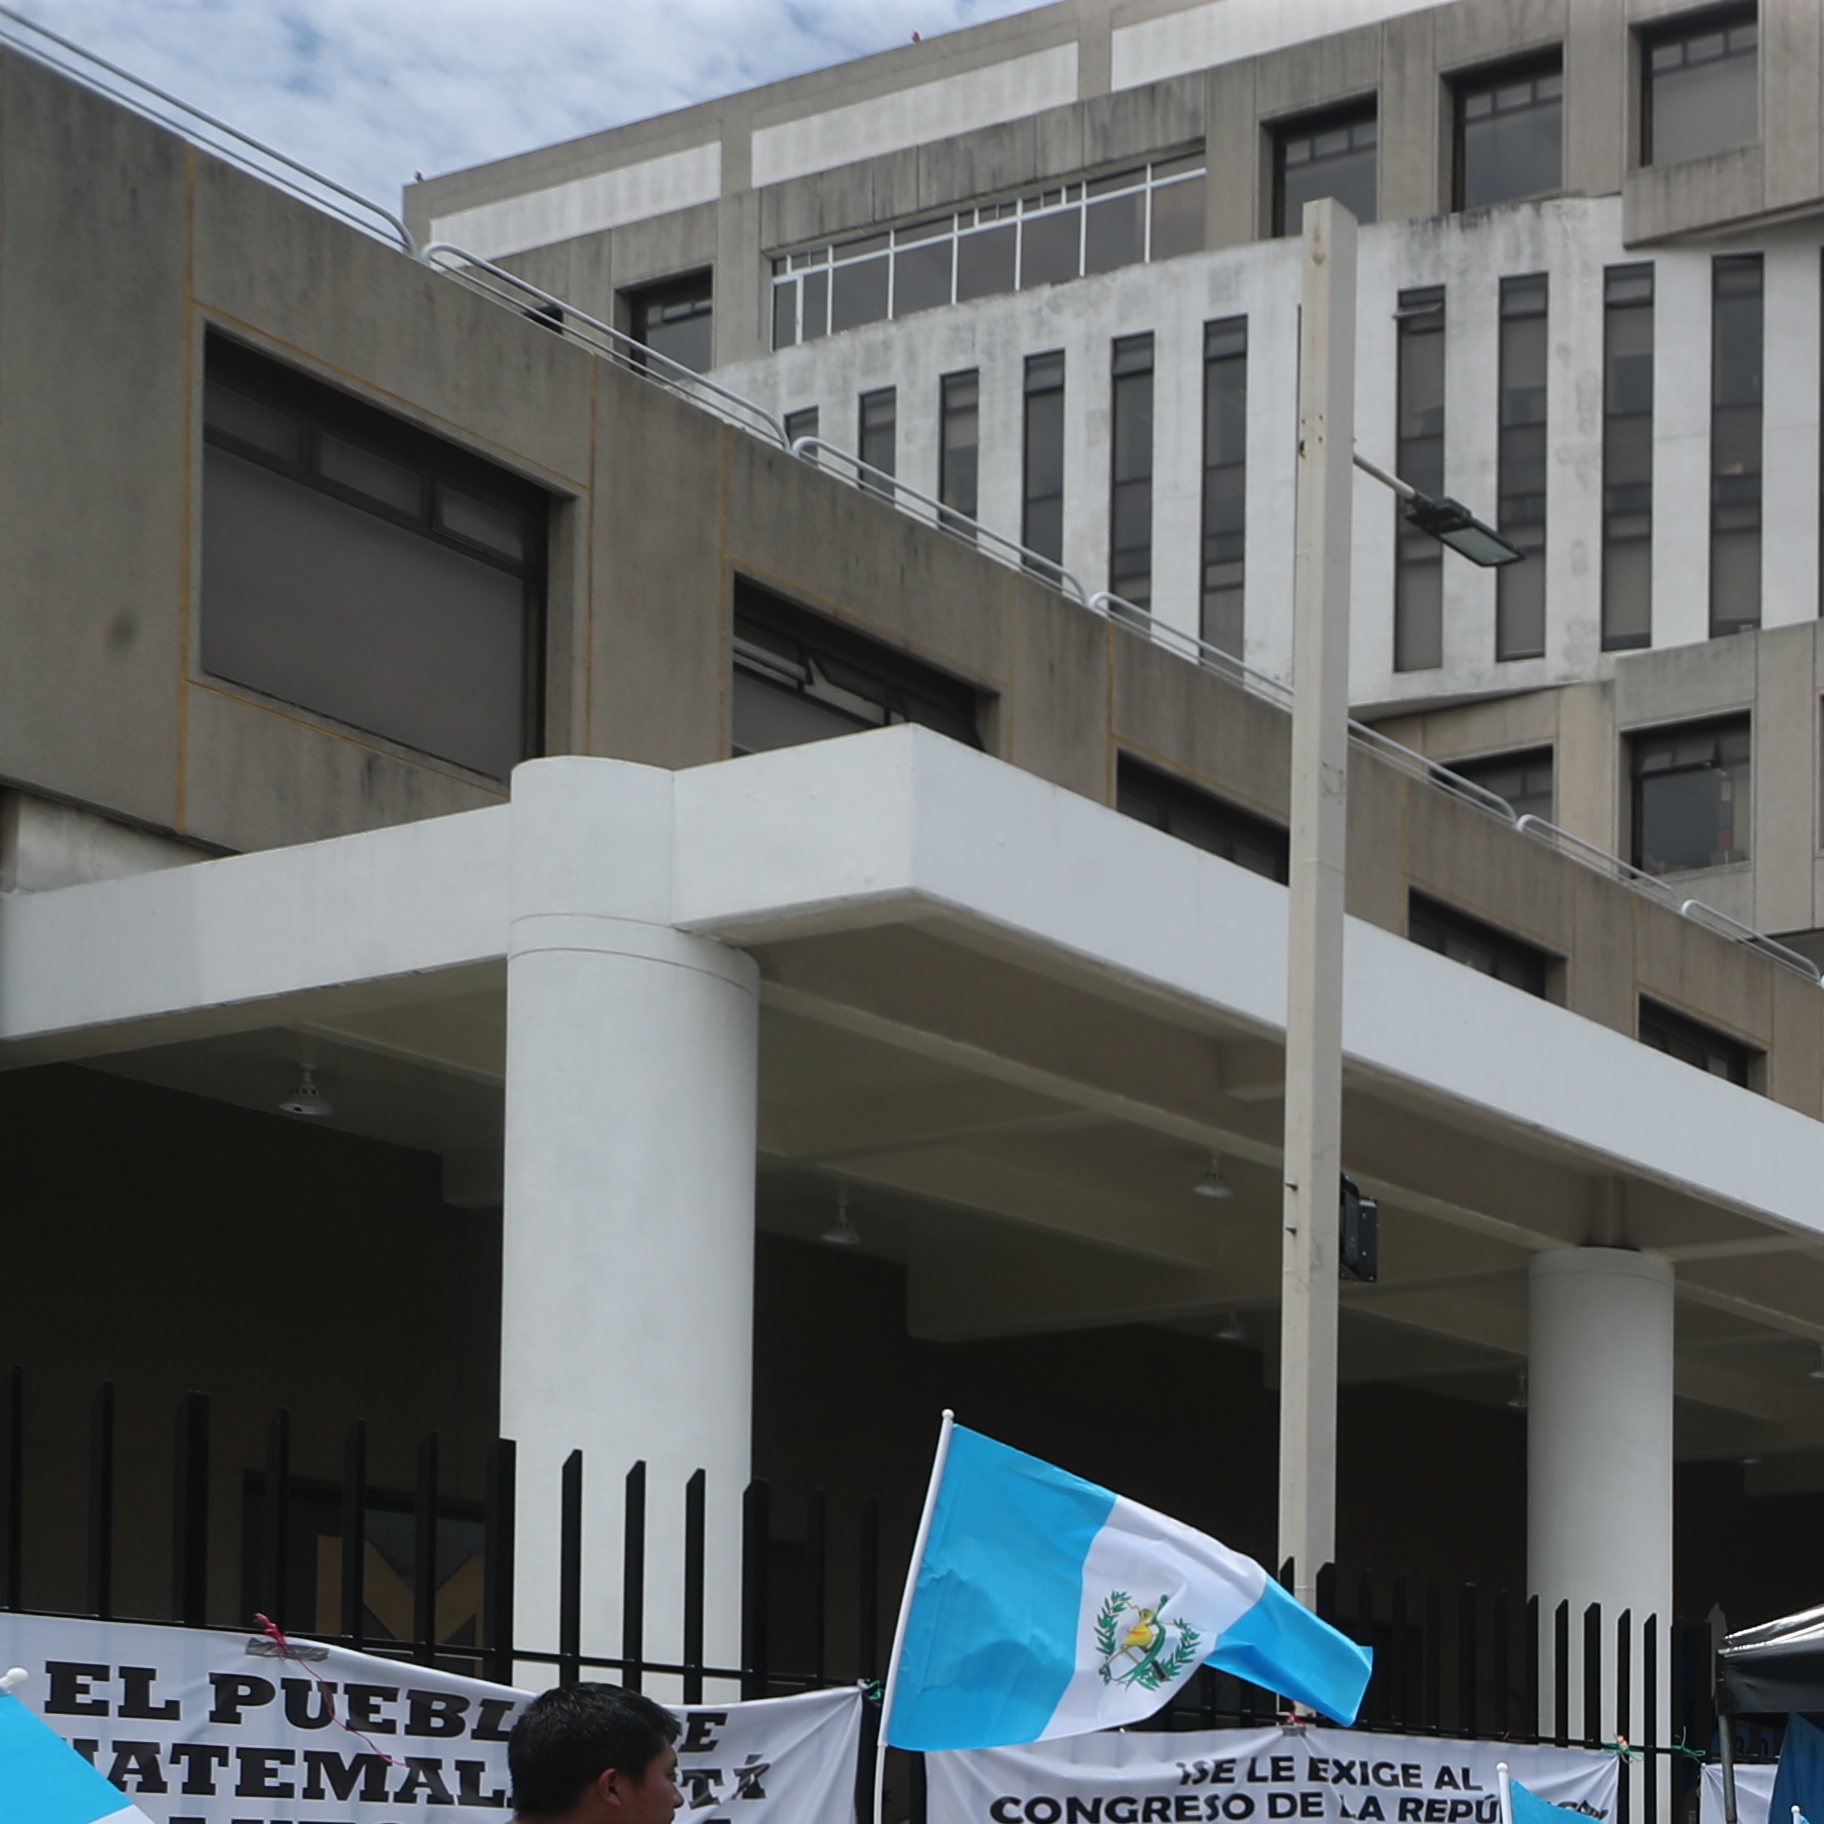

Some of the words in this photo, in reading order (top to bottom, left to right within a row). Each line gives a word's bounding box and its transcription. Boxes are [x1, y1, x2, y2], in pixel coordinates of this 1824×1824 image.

[44, 1660, 181, 1721] EL
[208, 1672, 511, 1741] PUEBL
[1247, 1755, 1295, 1784] LE
[1308, 1755, 1423, 1788] EXIGE
[1434, 1765, 1483, 1791] AL
[1267, 1792, 1324, 1819] DE
[1339, 1795, 1385, 1821] LA
